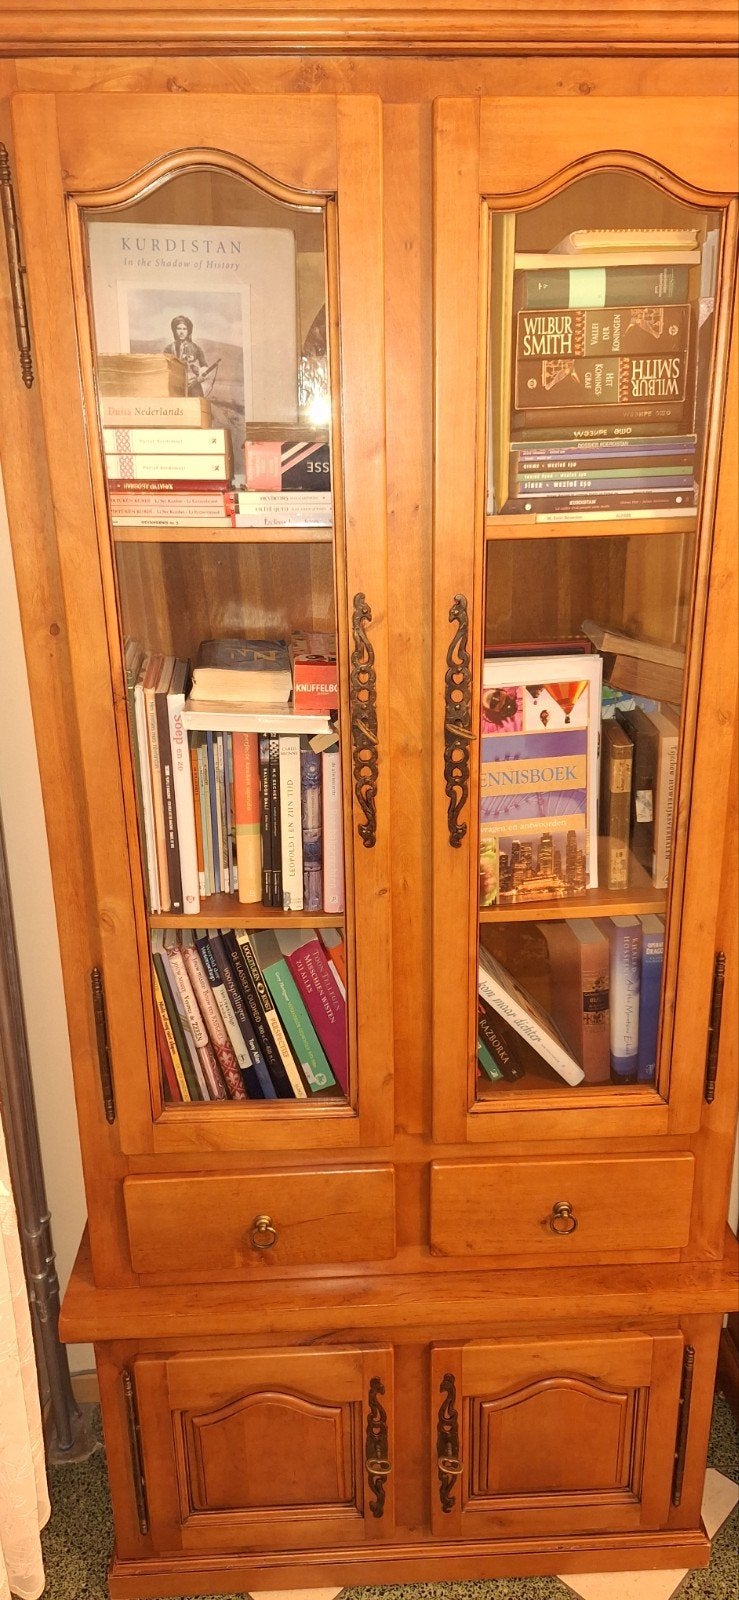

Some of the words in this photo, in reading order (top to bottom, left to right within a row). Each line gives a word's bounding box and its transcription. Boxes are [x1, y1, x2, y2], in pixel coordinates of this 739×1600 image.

[121, 238, 242, 254] KURDISTAN
[124, 257, 134, 266] In
[137, 258, 151, 266] the
[155, 258, 190, 268] Shadow
[194, 260, 204, 270] of
[206, 260, 240, 271] History
[524, 316, 572, 335] WILBUR
[612, 314, 621, 352] KONINGEN
[523, 333, 572, 356] SMITH
[632, 358, 680, 380] SMITH
[632, 379, 679, 396] WILBUR
[134, 407, 184, 416] Nederlands
[174, 715, 183, 744] soep
[178, 748, 184, 759] en
[178, 760, 184, 771] zo
[288, 822, 294, 832] EN
[520, 818, 566, 829] antwoorden
[223, 967, 245, 1022] voorspellingen
[230, 952, 237, 961] DE
[234, 962, 249, 993] KLASSIEKE
[247, 994, 262, 1023] OUDHEID
[304, 954, 323, 996] MISSCHIEN
[322, 997, 336, 1024] WISTEN
[492, 998, 516, 1019] maar
[514, 1016, 542, 1043] dichter
[247, 1038, 257, 1050] Tony
[479, 1019, 509, 1064] RAZBORKA
